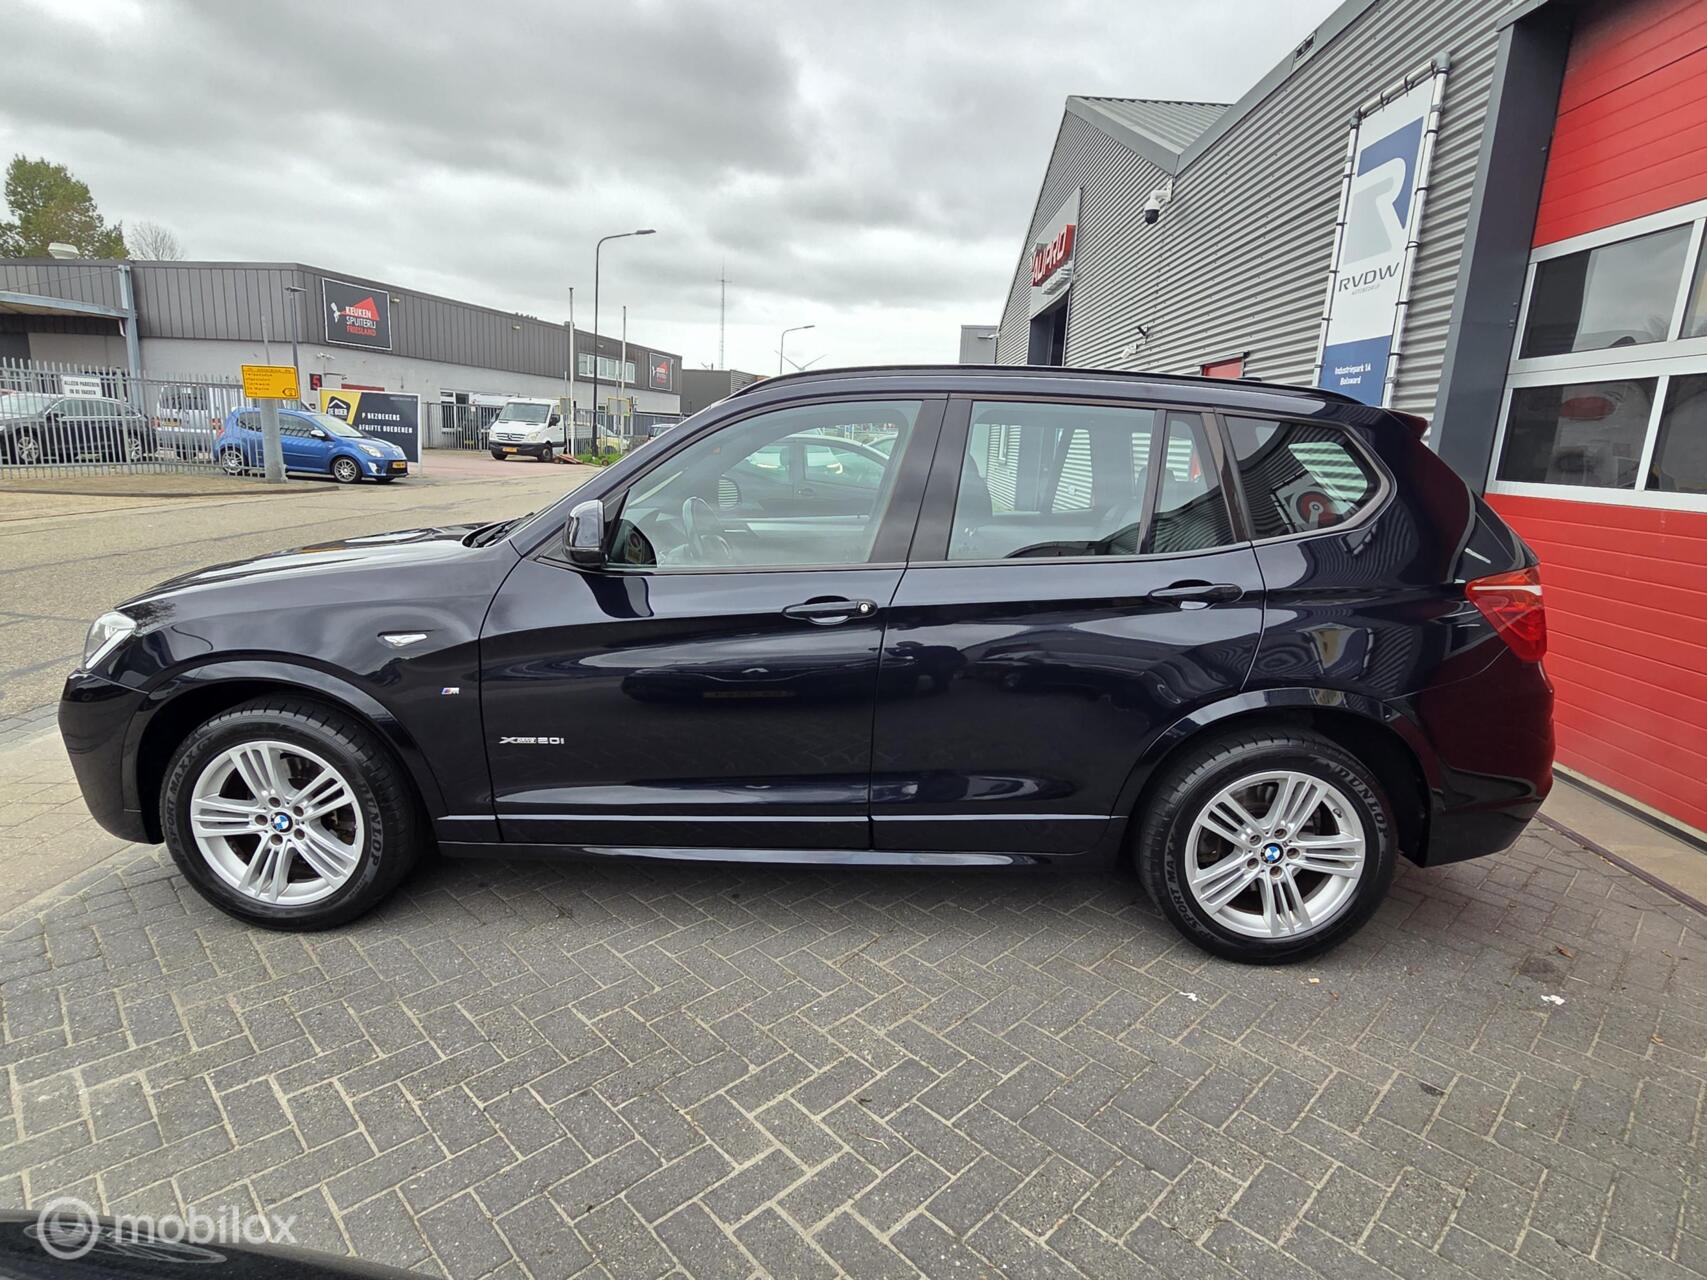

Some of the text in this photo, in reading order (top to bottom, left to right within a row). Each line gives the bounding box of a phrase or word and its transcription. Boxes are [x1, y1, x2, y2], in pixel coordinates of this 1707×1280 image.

[1338, 262, 1400, 292] RVDW
[346, 306, 371, 319] KEUKEN
[346, 316, 376, 329] SPUITERIJ
[312, 375, 320, 389] 5
[367, 413, 400, 421] BEZOEKERS
[359, 424, 381, 432] AFGIFTE
[1338, 765, 1390, 839] DUNLOP
[359, 782, 382, 867] DUNLOP
[1170, 887, 1202, 930] SPORT
